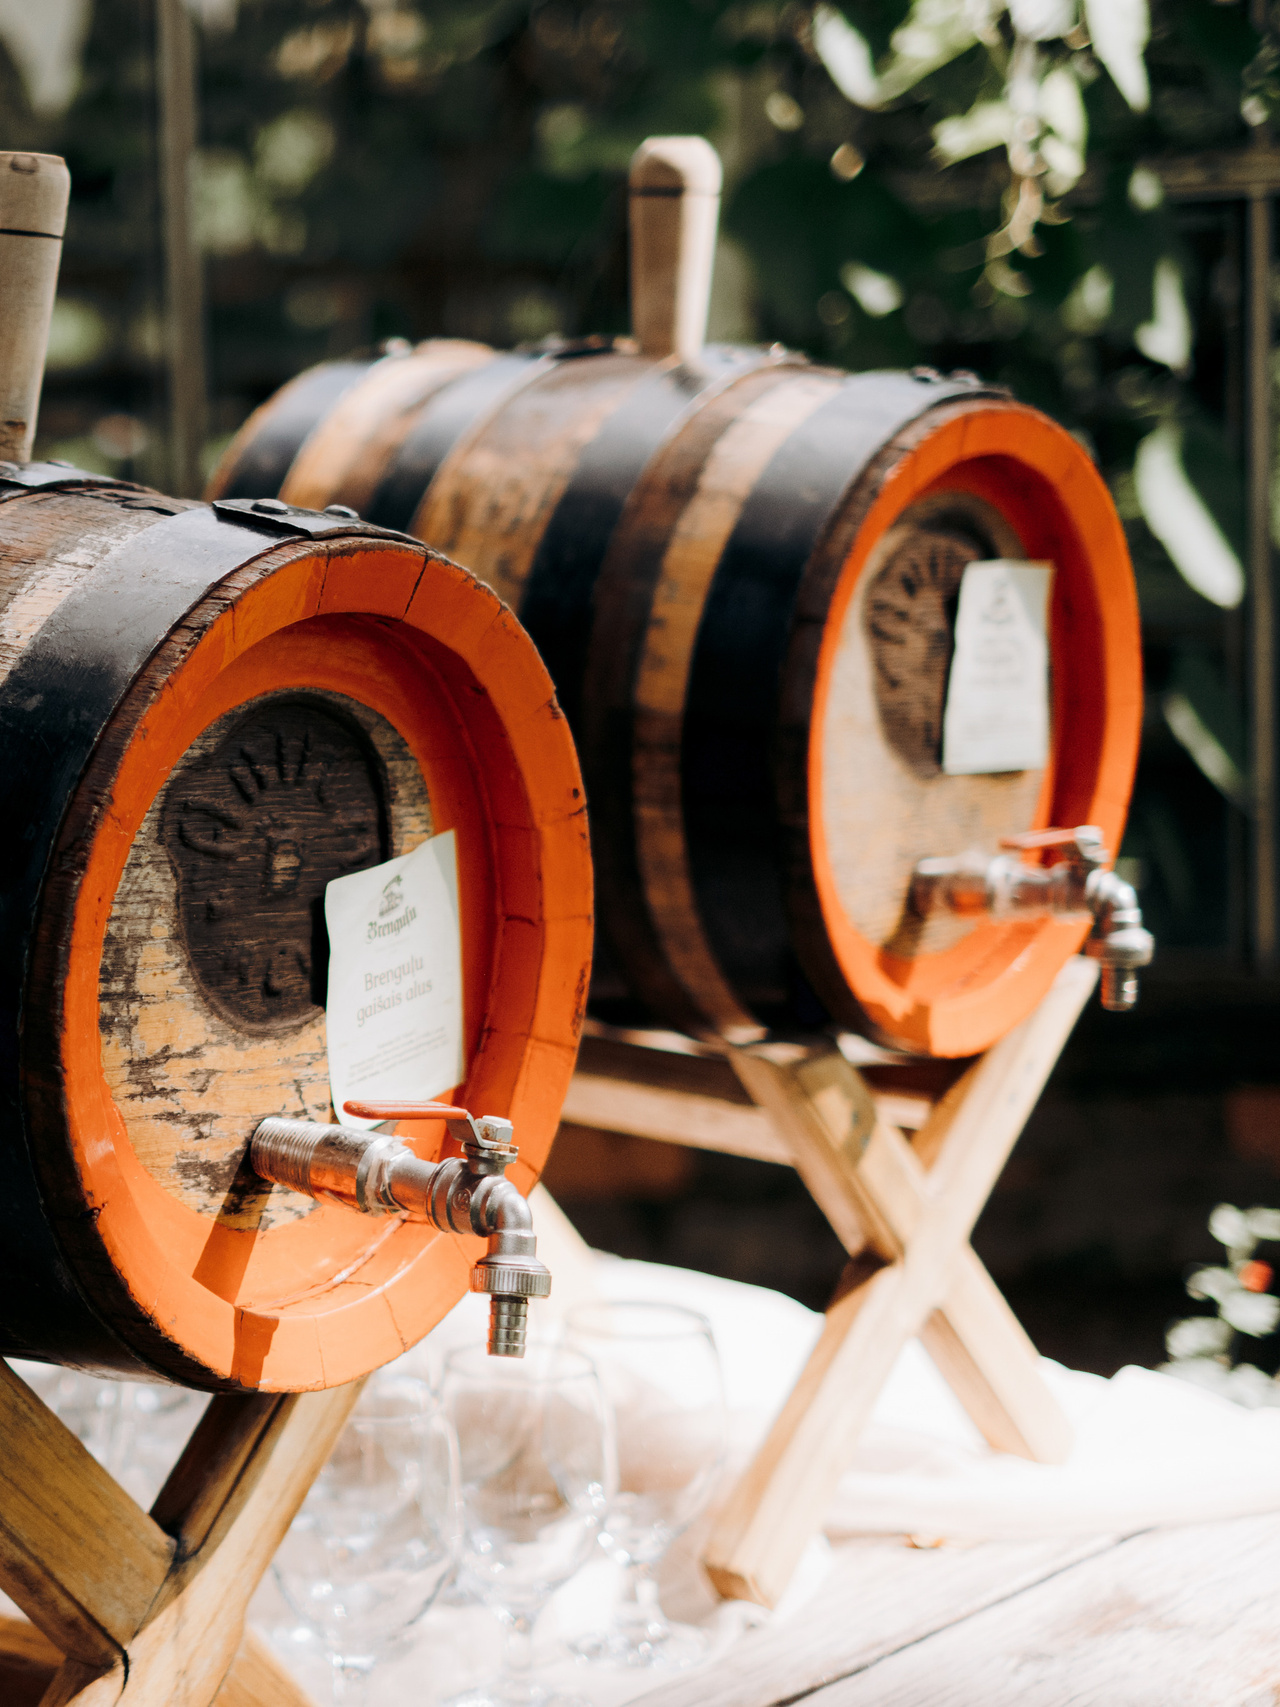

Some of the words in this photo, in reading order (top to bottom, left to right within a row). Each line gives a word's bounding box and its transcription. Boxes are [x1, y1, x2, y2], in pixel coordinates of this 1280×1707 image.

[364, 955, 424, 991] Brenguļu
[356, 990, 402, 1027] gaišais
[407, 979, 433, 1001] alus
